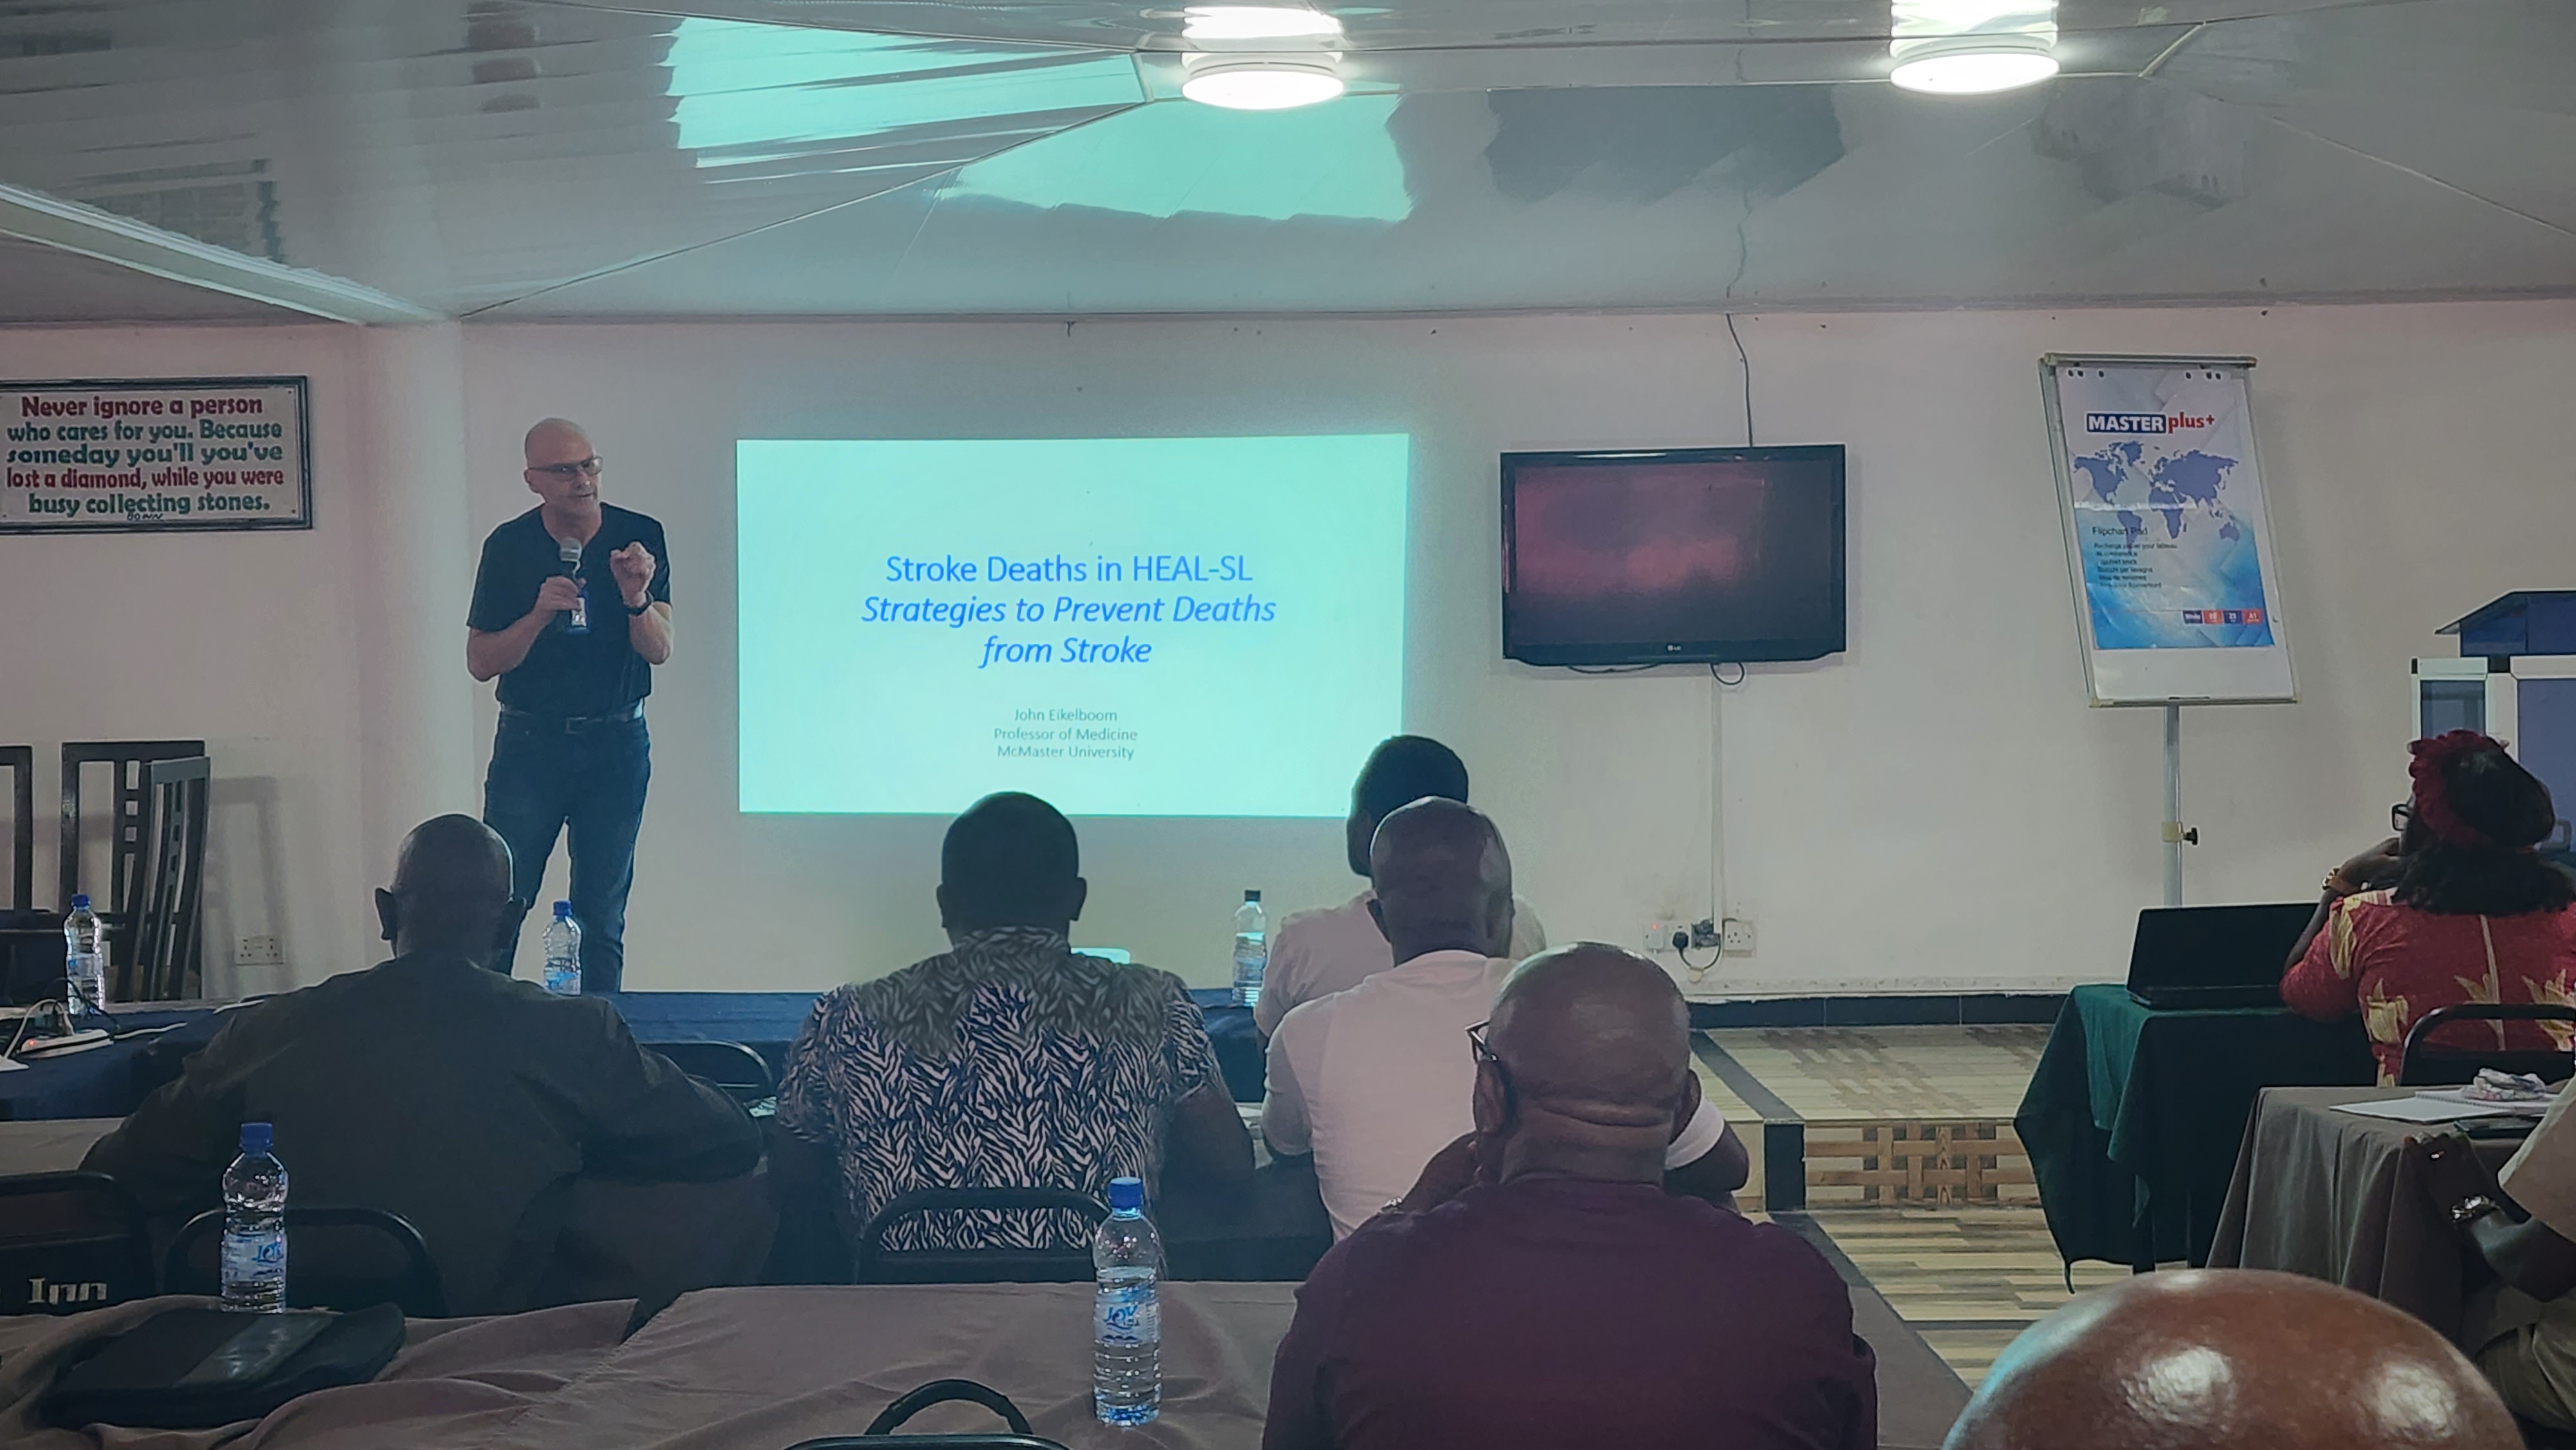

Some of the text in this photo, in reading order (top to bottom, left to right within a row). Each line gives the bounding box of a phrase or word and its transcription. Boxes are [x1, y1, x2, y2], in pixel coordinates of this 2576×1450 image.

[21, 396, 263, 419] Never ignore a person
[7, 419, 282, 444] who cares for you. Because
[2088, 415, 2164, 431] MASTER
[6, 441, 283, 467] someday you'll you've
[6, 466, 284, 490] lost a diamond, while you were
[29, 493, 270, 518] busy collecting stones.
[886, 554, 1253, 581] Stroke Deaths in HEAL-SL
[861, 594, 1277, 628] Strategies to Prevent Deaths
[978, 635, 1152, 669] from Stroke
[1014, 708, 1118, 722] John Eikelboom
[994, 727, 1138, 740] Professor of Medicine
[997, 746, 1135, 760] McMaster University
[28, 1277, 108, 1304] Inn
